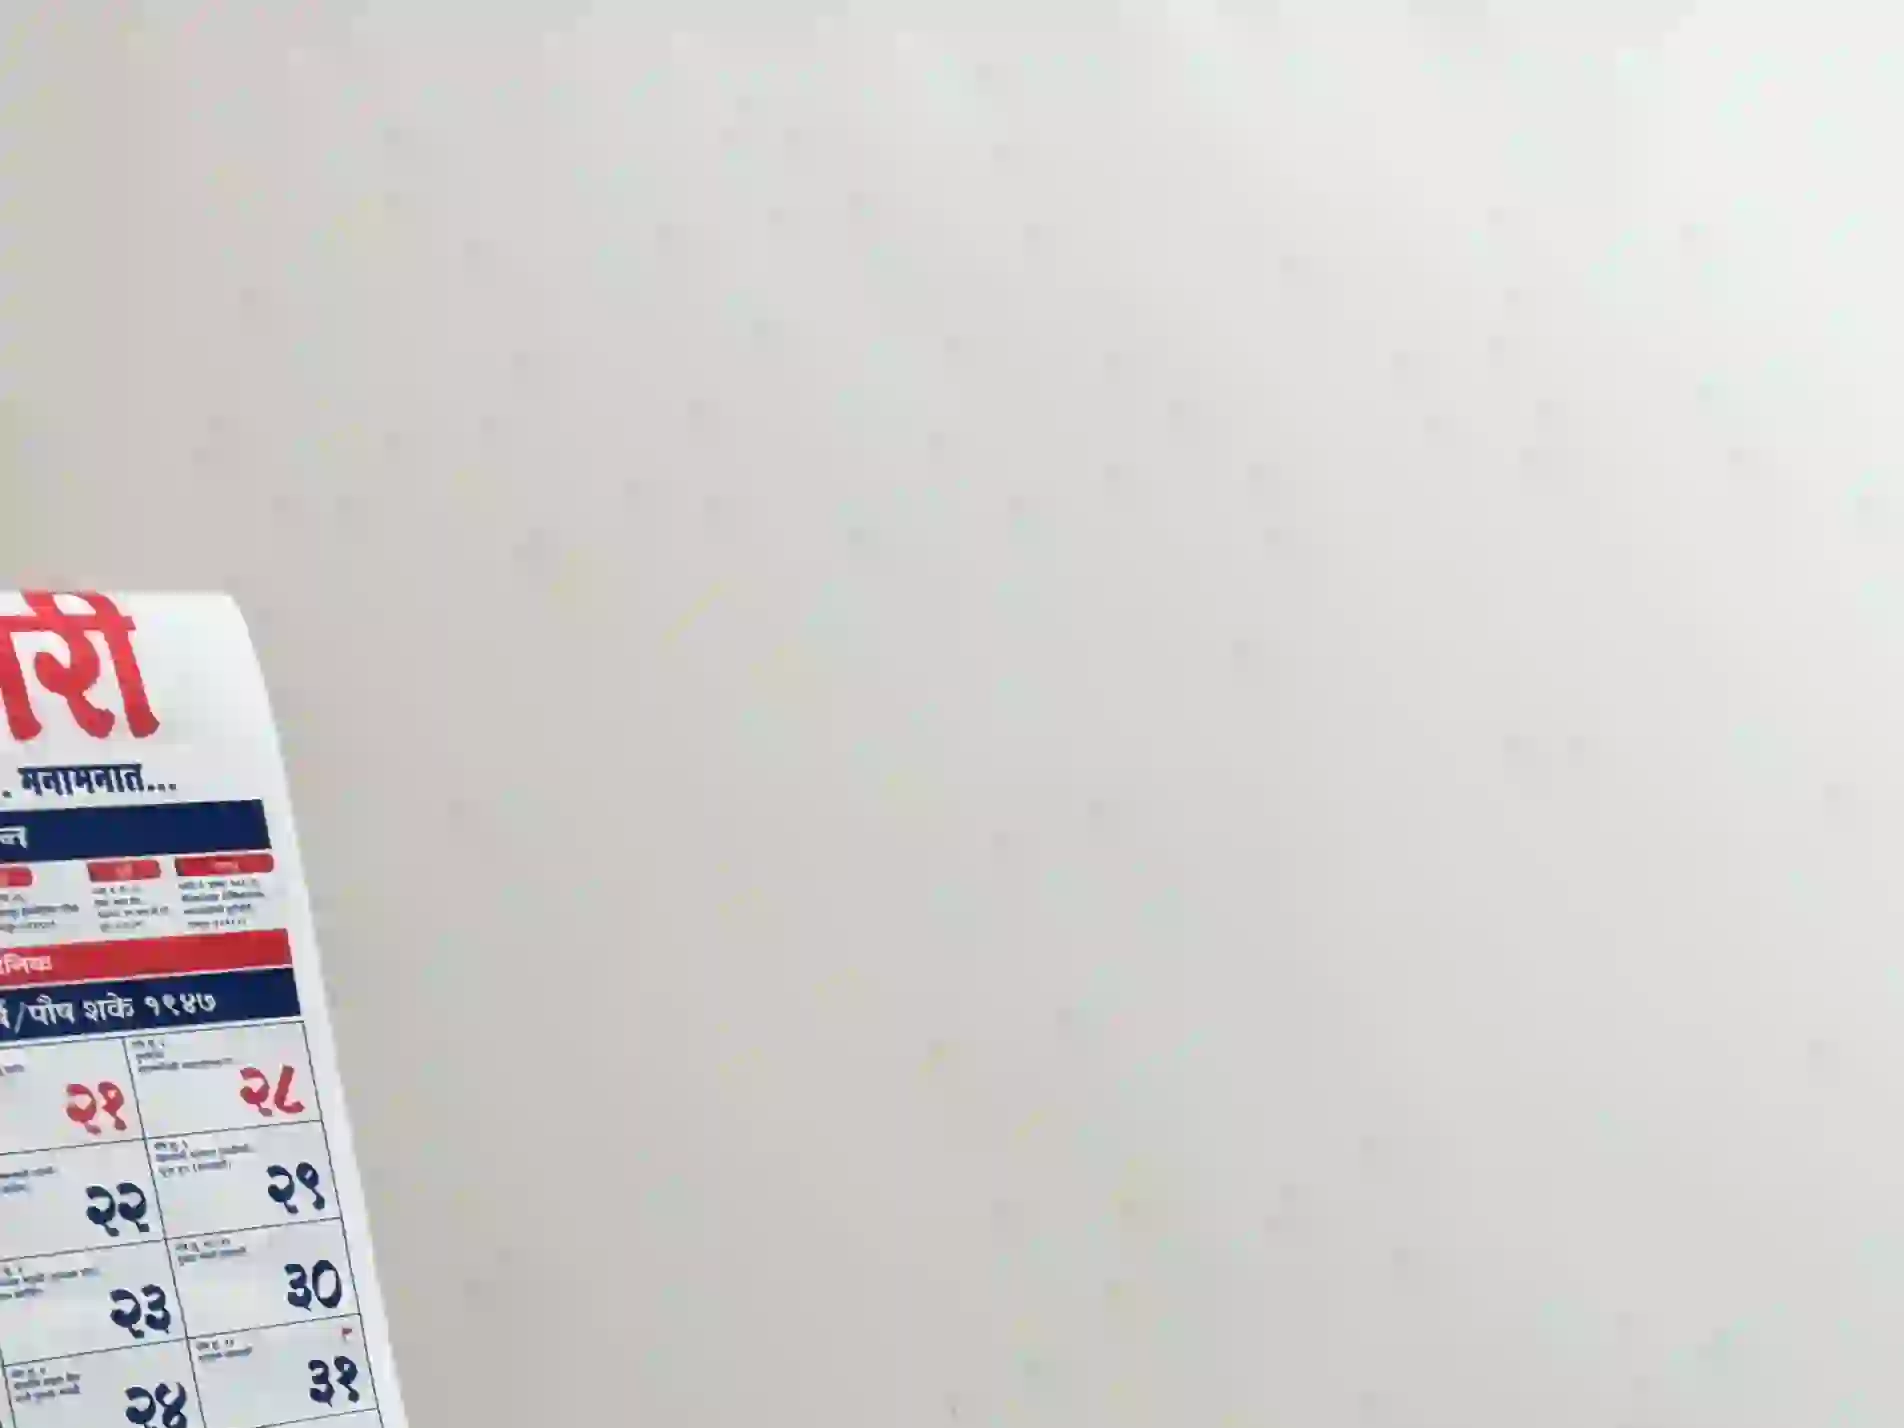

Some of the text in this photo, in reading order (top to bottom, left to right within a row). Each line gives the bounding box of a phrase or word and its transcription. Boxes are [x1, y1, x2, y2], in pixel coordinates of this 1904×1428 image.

[0, 588, 160, 741] री
[240, 1065, 305, 1117] २८
[86, 1182, 150, 1236] २२
[109, 1259, 342, 1338] २३ ३०
[308, 1355, 358, 1407] ३१
